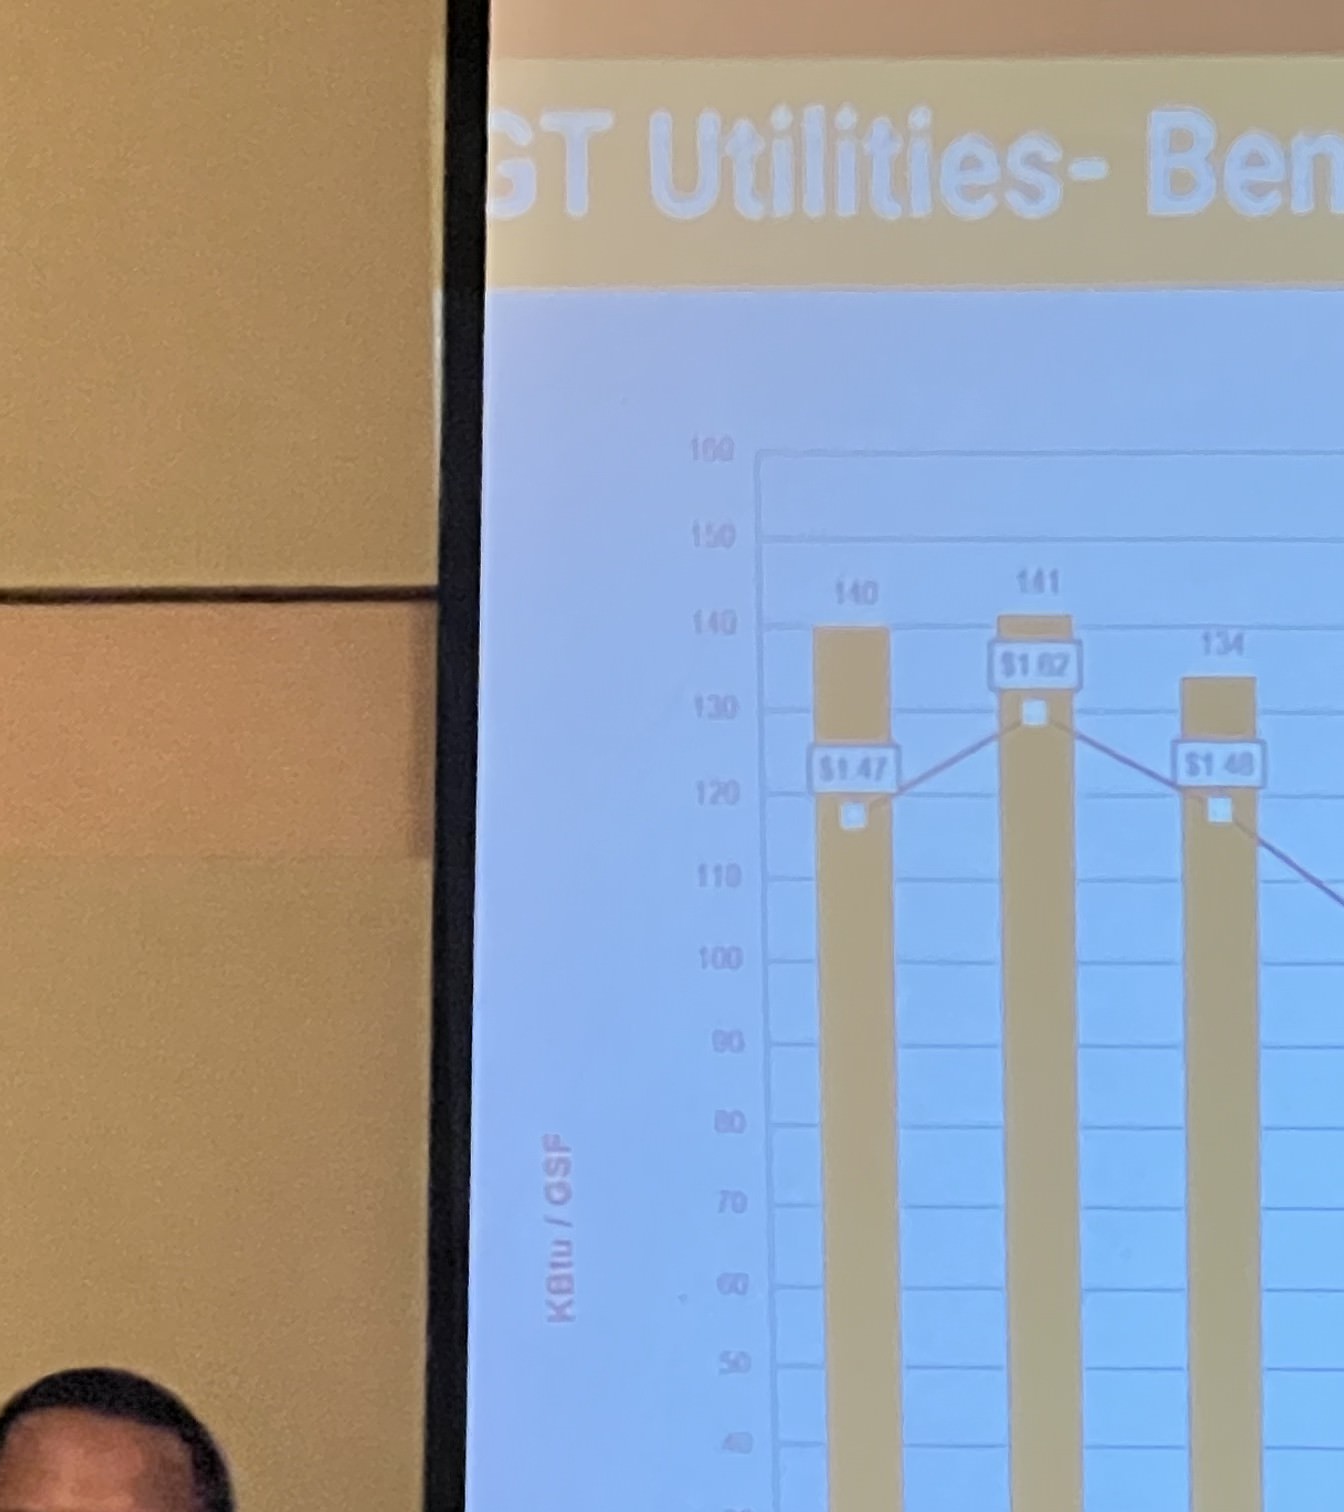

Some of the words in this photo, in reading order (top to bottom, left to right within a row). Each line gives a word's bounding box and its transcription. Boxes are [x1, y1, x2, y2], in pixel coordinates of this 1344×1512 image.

[648, 101, 1109, 221] Utilities-
[691, 436, 734, 462] 160
[692, 522, 736, 549] 150
[836, 580, 878, 605] 140
[1017, 568, 1058, 594] 141
[693, 609, 737, 636] 140
[1202, 630, 1246, 657] 134
[694, 695, 740, 719] 130
[820, 756, 887, 781] $1.47
[697, 780, 740, 805] 120
[698, 863, 742, 888] 110
[699, 946, 743, 970] 100
[718, 1190, 747, 1214] 70
[716, 1273, 749, 1296] 60
[719, 1351, 751, 1375] 50
[721, 1432, 753, 1454] 40
